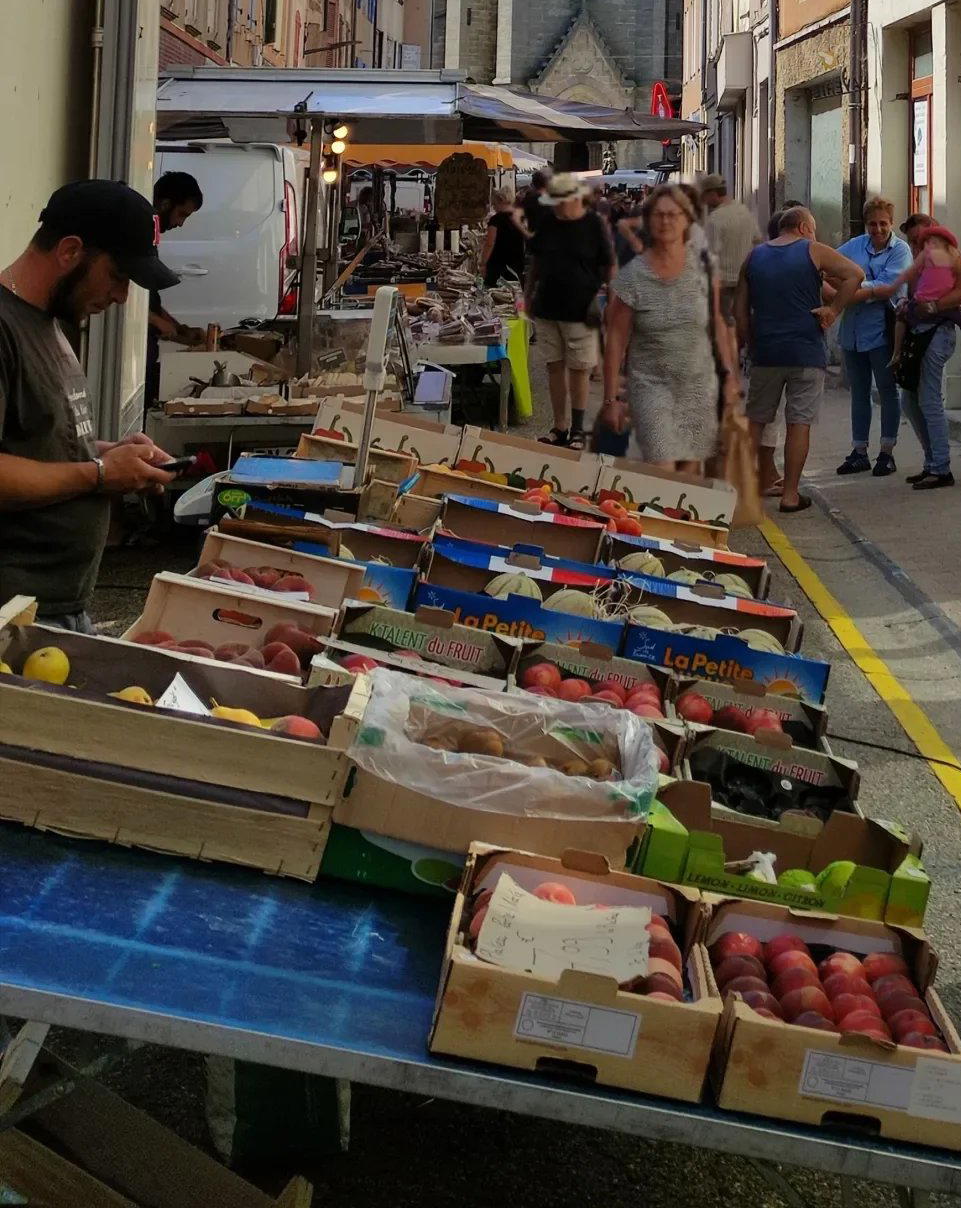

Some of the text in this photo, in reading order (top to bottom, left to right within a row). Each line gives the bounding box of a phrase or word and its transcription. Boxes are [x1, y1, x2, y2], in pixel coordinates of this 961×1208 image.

[483, 613, 546, 642] Petite
[428, 638, 445, 656] du
[447, 640, 484, 663] FRUIT
[664, 647, 754, 682] La Petite
[789, 765, 825, 785] FRUIT
